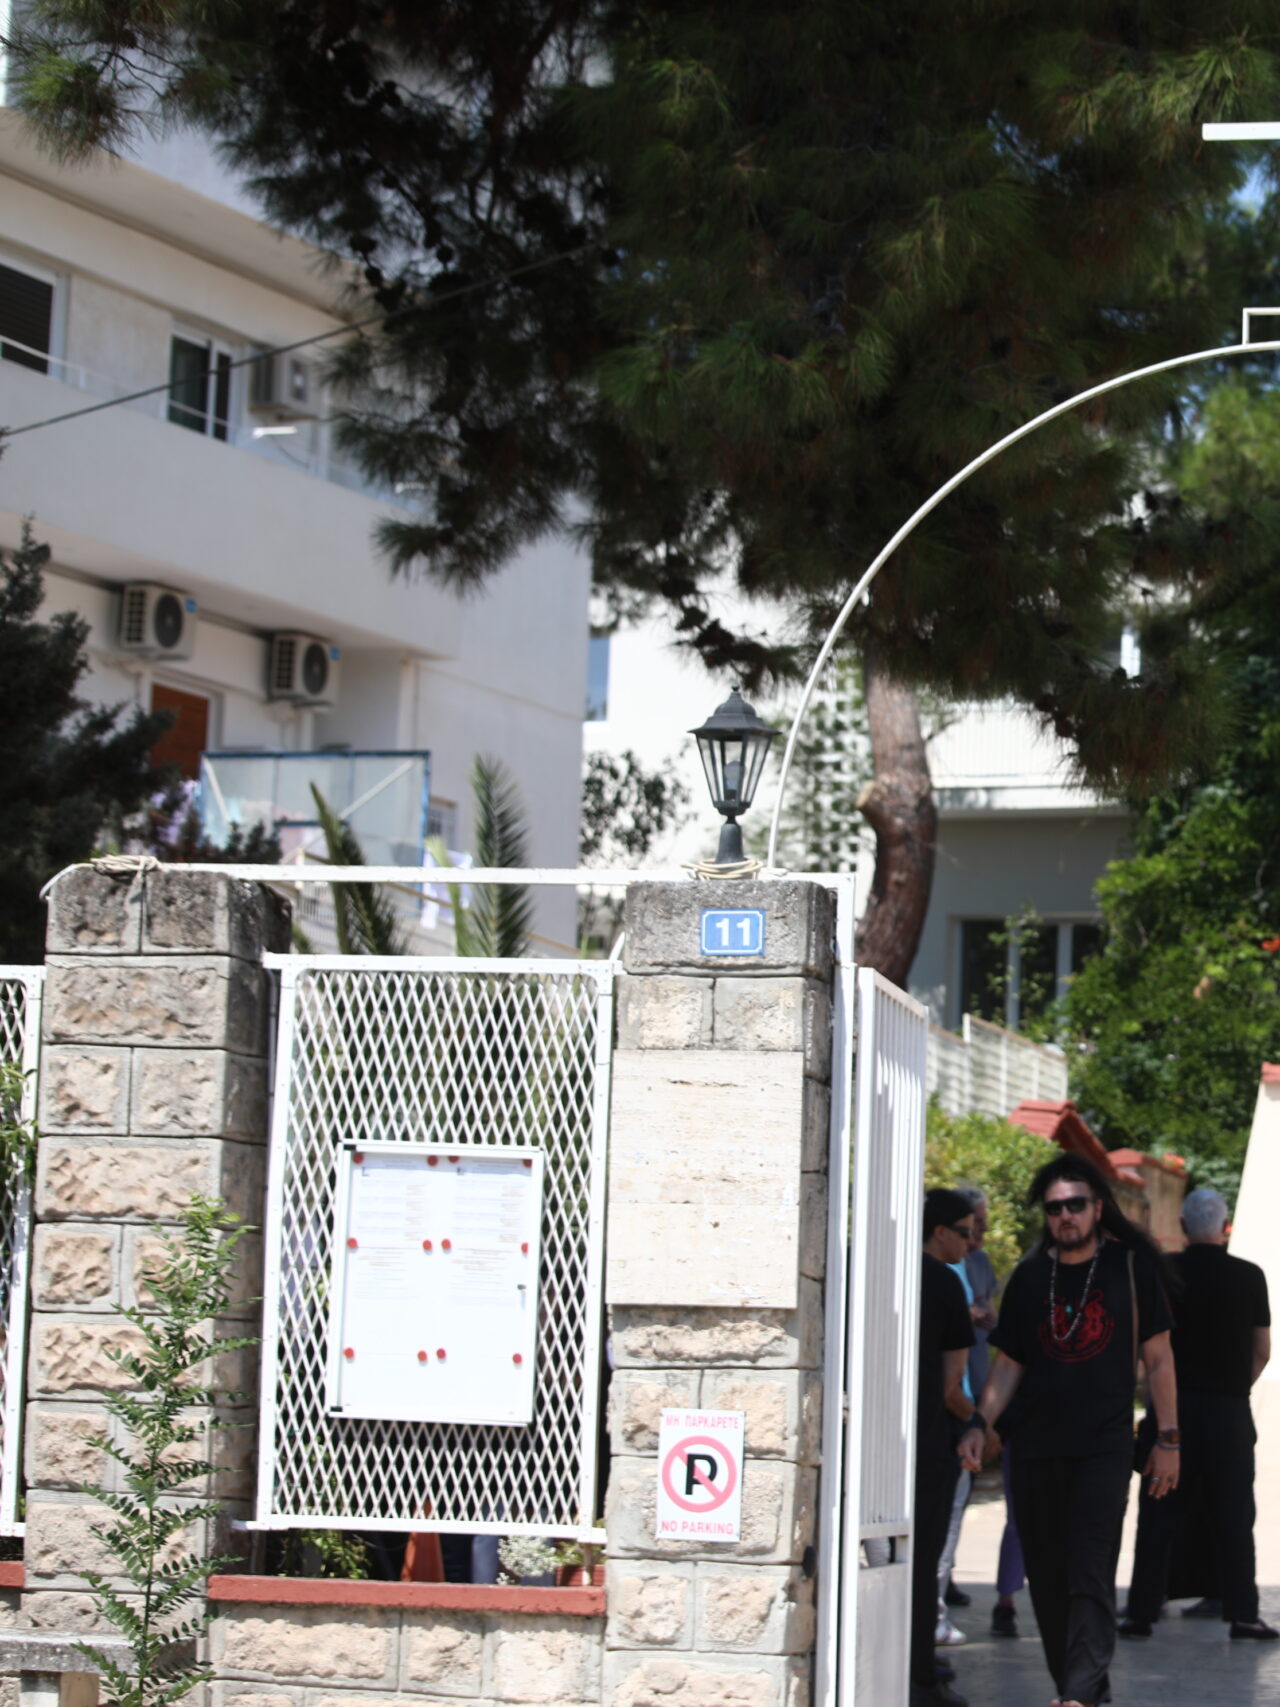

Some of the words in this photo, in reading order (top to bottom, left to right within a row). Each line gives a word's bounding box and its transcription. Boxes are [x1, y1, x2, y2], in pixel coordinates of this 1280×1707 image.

[715, 918, 750, 946] 11
[685, 1416, 740, 1430] ΠΑΡΚΑΡΕΤΕ
[661, 1520, 678, 1532] NO
[681, 1521, 734, 1535] PARKING
